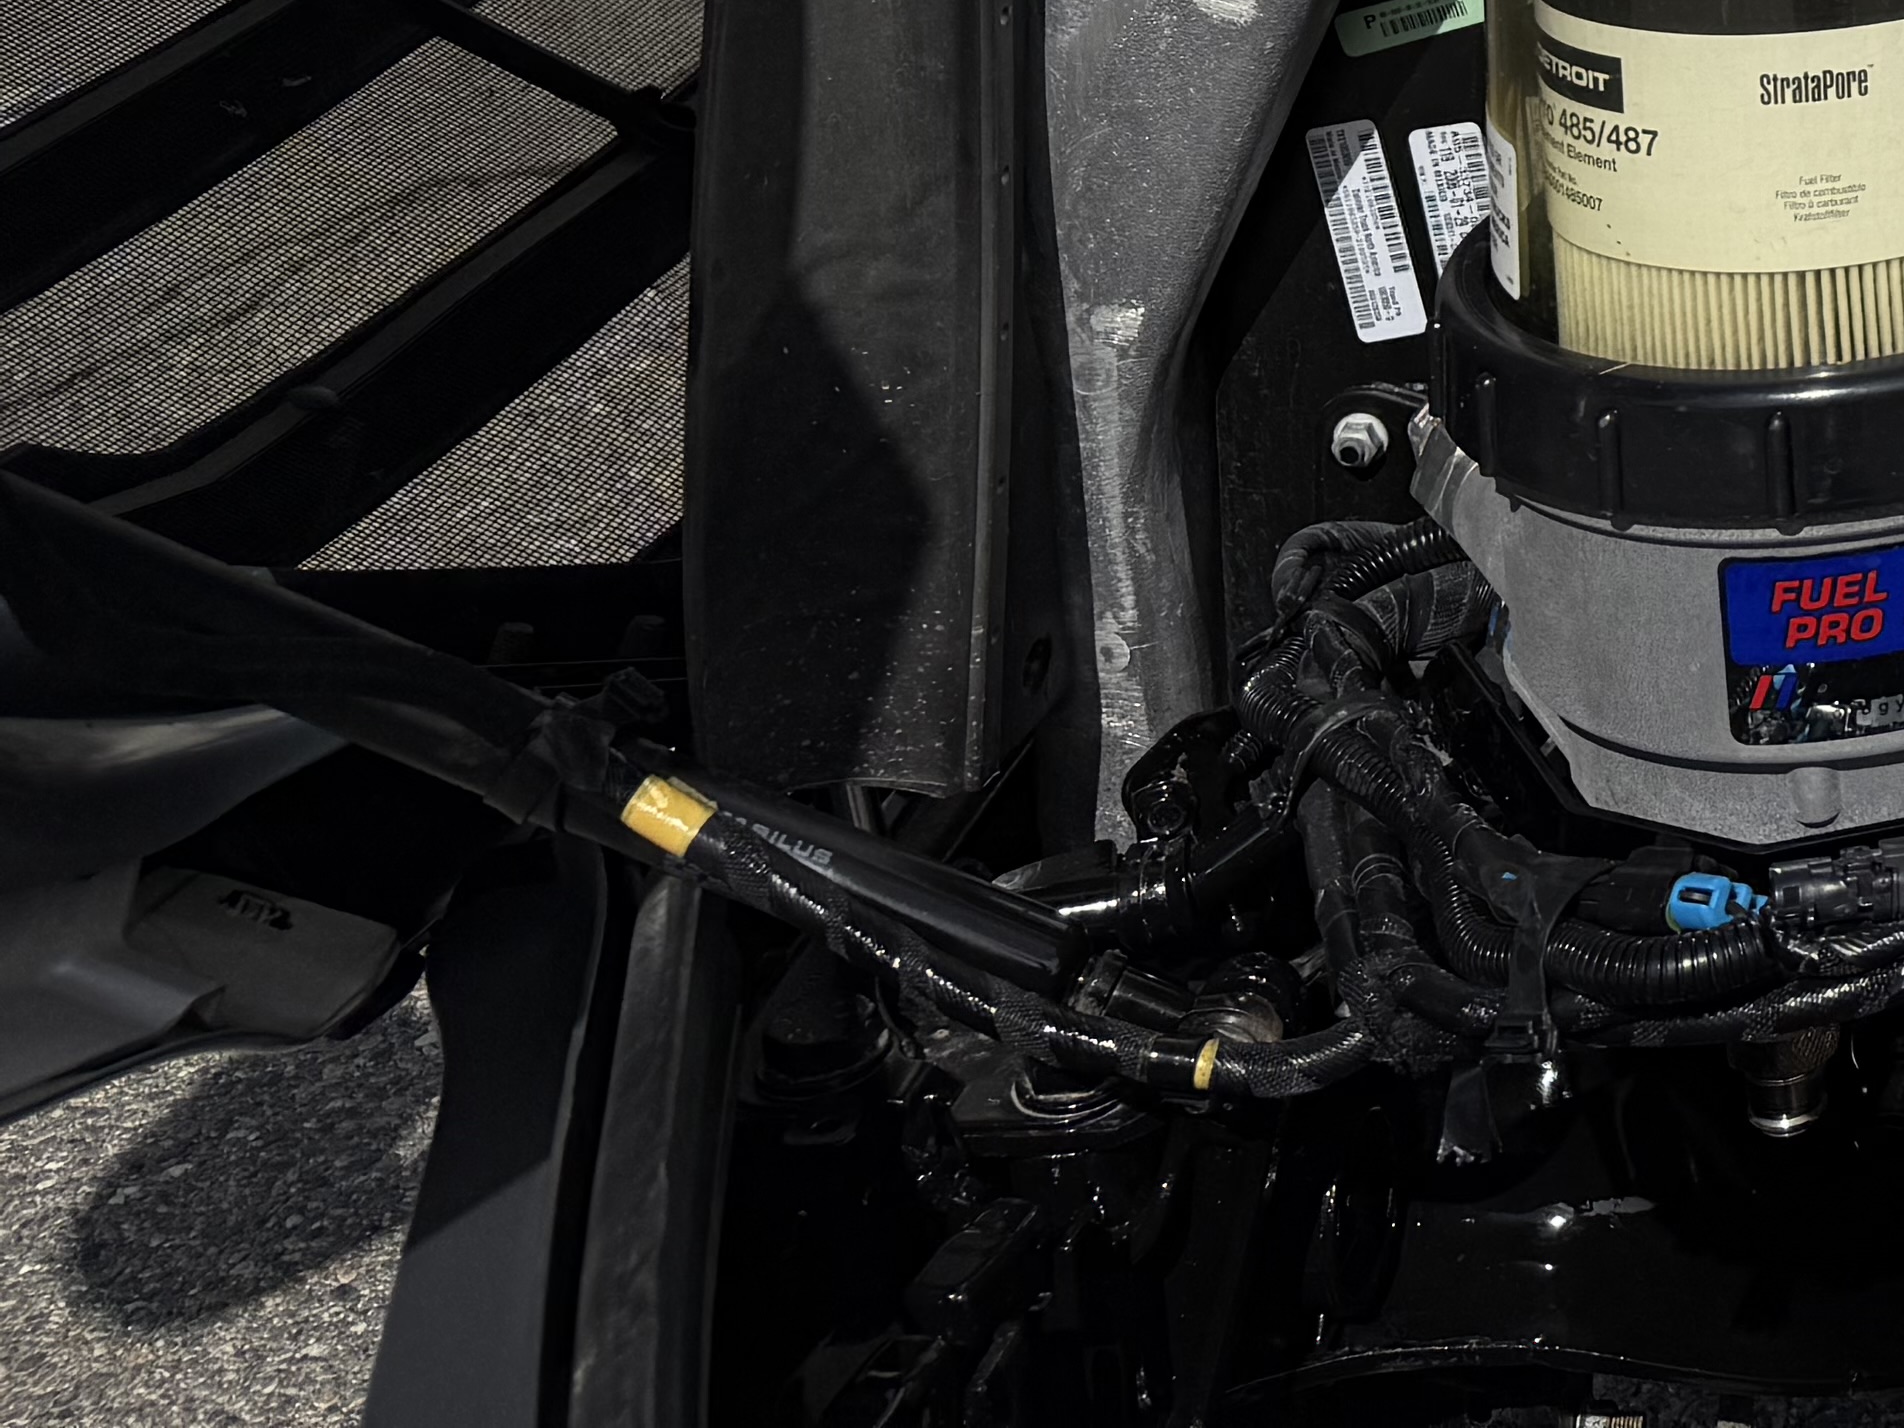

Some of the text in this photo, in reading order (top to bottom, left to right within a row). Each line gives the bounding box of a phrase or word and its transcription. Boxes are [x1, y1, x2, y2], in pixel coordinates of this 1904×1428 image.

[1362, 14, 1377, 30] P
[1539, 49, 1610, 92] ETROIT
[1558, 107, 1659, 157] 485/487
[1431, 157, 1439, 167] IN
[1566, 142, 1618, 173] Element
[1798, 173, 1842, 186] Fuel Filter
[1799, 189, 1811, 199] de
[1813, 183, 1867, 198] combustible
[1816, 195, 1859, 209] carburant
[1770, 569, 1888, 613] FUEL
[1785, 608, 1885, 649] PRO
